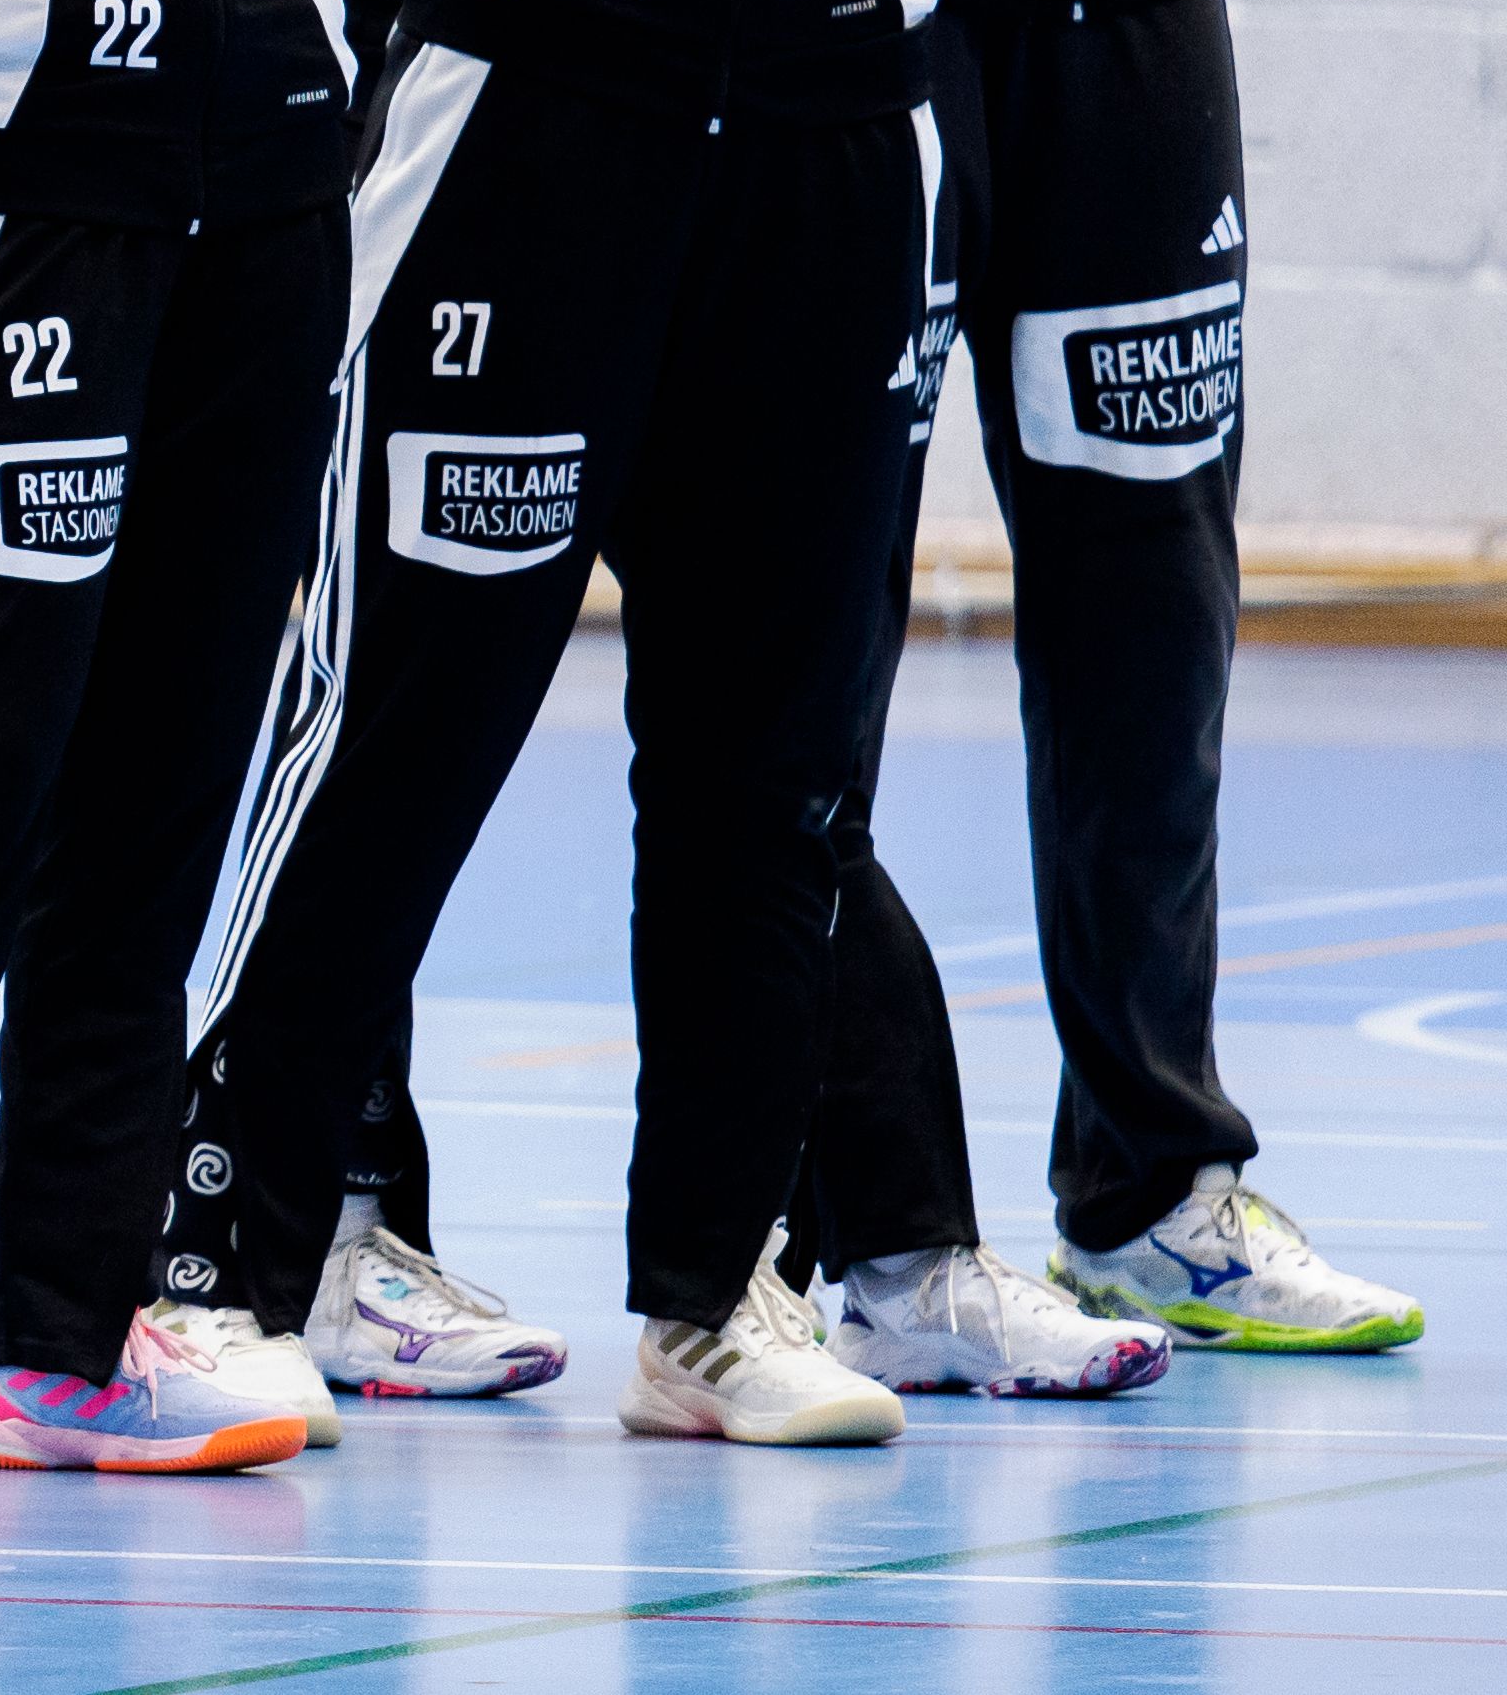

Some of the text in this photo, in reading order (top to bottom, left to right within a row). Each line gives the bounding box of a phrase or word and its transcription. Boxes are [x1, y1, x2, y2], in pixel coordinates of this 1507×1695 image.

[2, 316, 78, 398] 22
[432, 301, 491, 376] 27
[1089, 316, 1241, 385] REKLAME
[1096, 366, 1239, 433] STASJONEN
[18, 465, 125, 506] REKLAME
[441, 461, 582, 497] REKLAME
[440, 499, 577, 536] STASJONEN
